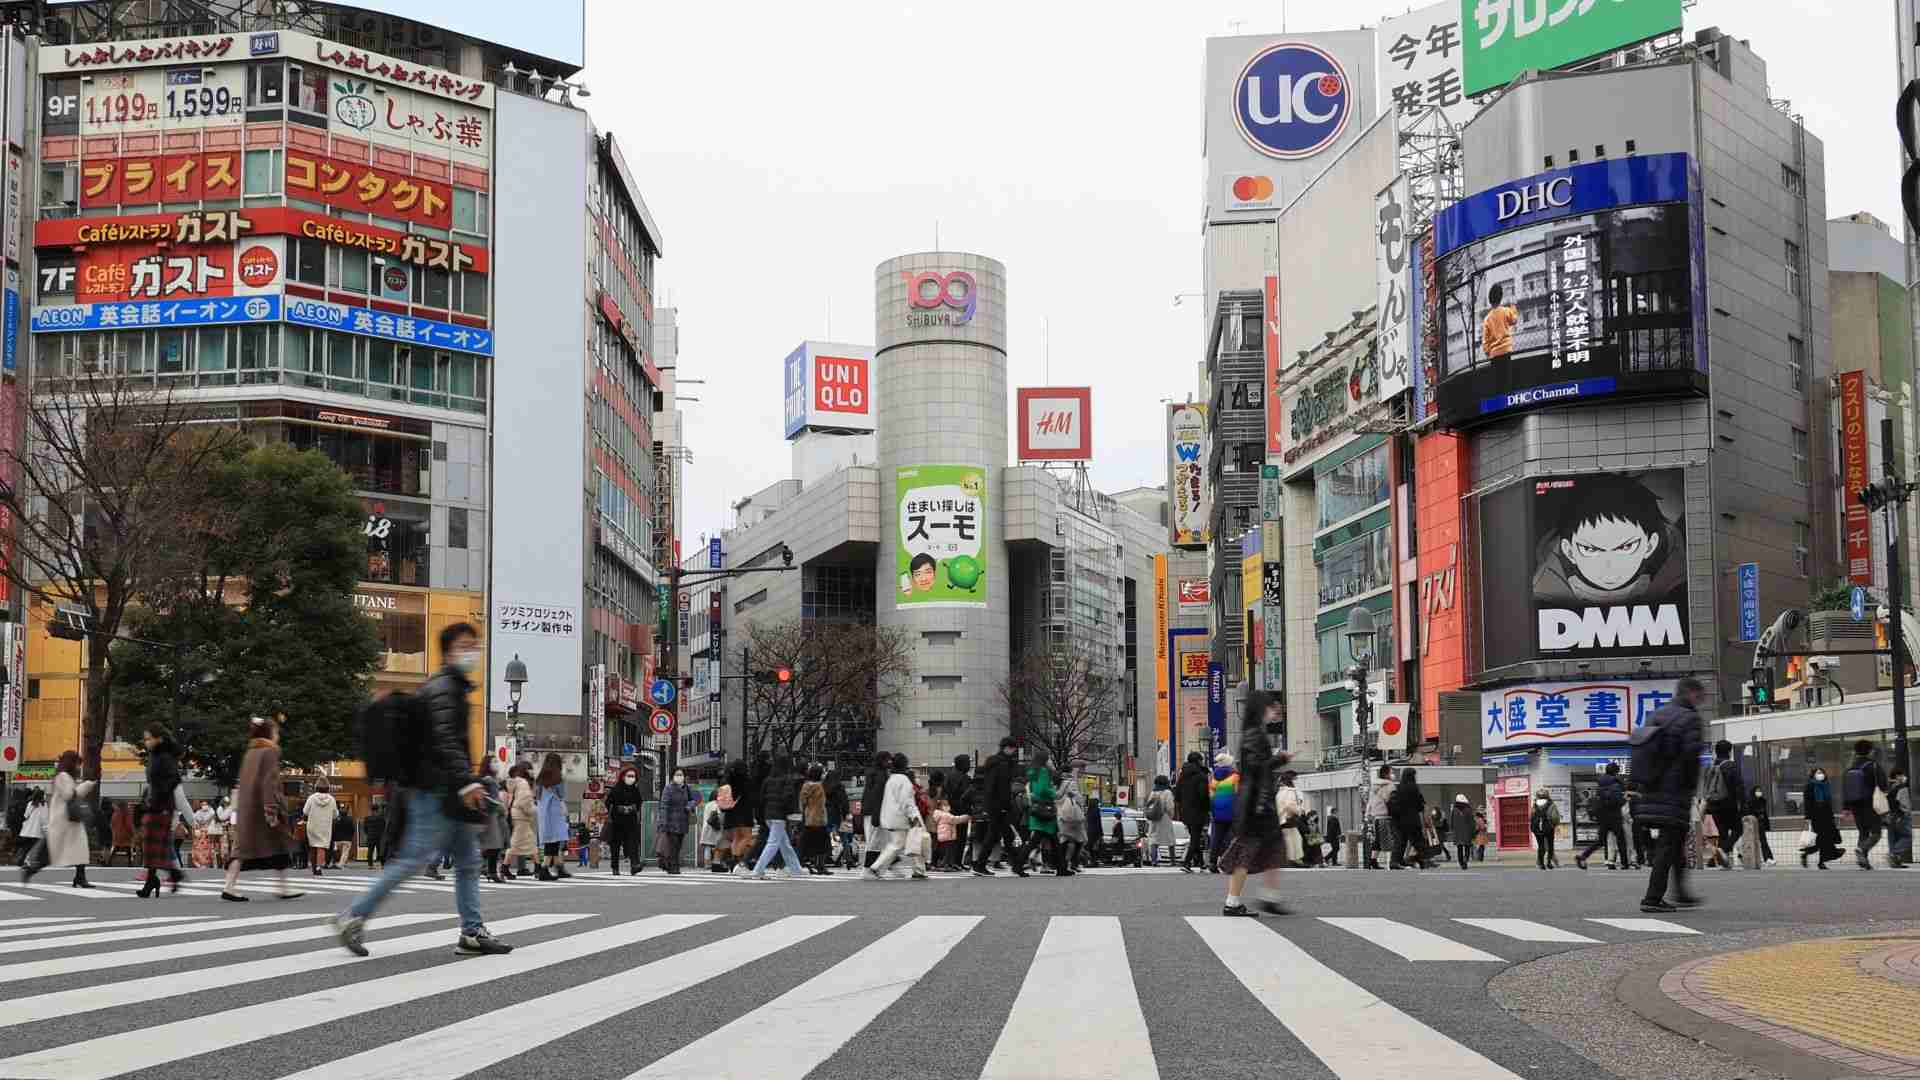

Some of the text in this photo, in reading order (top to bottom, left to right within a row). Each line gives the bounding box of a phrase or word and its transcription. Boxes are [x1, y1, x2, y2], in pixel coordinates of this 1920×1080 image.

[1388, 22, 1460, 70] 今年
[48, 95, 77, 116] 9F
[86, 92, 158, 128] 1,199円
[166, 86, 242, 123] 1,599円
[1247, 71, 1339, 125] UC
[1392, 68, 1461, 118] 発毛
[386, 95, 482, 147] しゃぶ葉
[83, 156, 238, 197] プライス
[287, 156, 446, 216] コンタクト
[1497, 177, 1572, 221] DHC
[177, 210, 251, 243] ガスト
[243, 263, 274, 277] ガスト
[401, 236, 473, 272] ガスト
[40, 266, 75, 292] 7F
[85, 264, 125, 282] Café
[129, 255, 225, 296] ガスト
[1380, 188, 1409, 387] もんじゃ
[39, 299, 270, 326] AEON 英会話イーオン 6F
[902, 271, 976, 322] 109
[294, 304, 489, 349] AEON 英会話イーオン
[907, 315, 949, 327] SHIBUYA
[821, 364, 858, 384] UNI
[821, 386, 861, 408] QLO
[1507, 385, 1579, 406] DHC Channel
[907, 499, 975, 513] 住まい探しは
[907, 515, 975, 541] スーモ
[1848, 504, 1870, 578] 三千里
[344, 592, 397, 609] ITANE
[501, 619, 572, 634] デザイン製作中
[1538, 604, 1684, 650] DMM
[1212, 669, 1221, 704] MIZUHO
